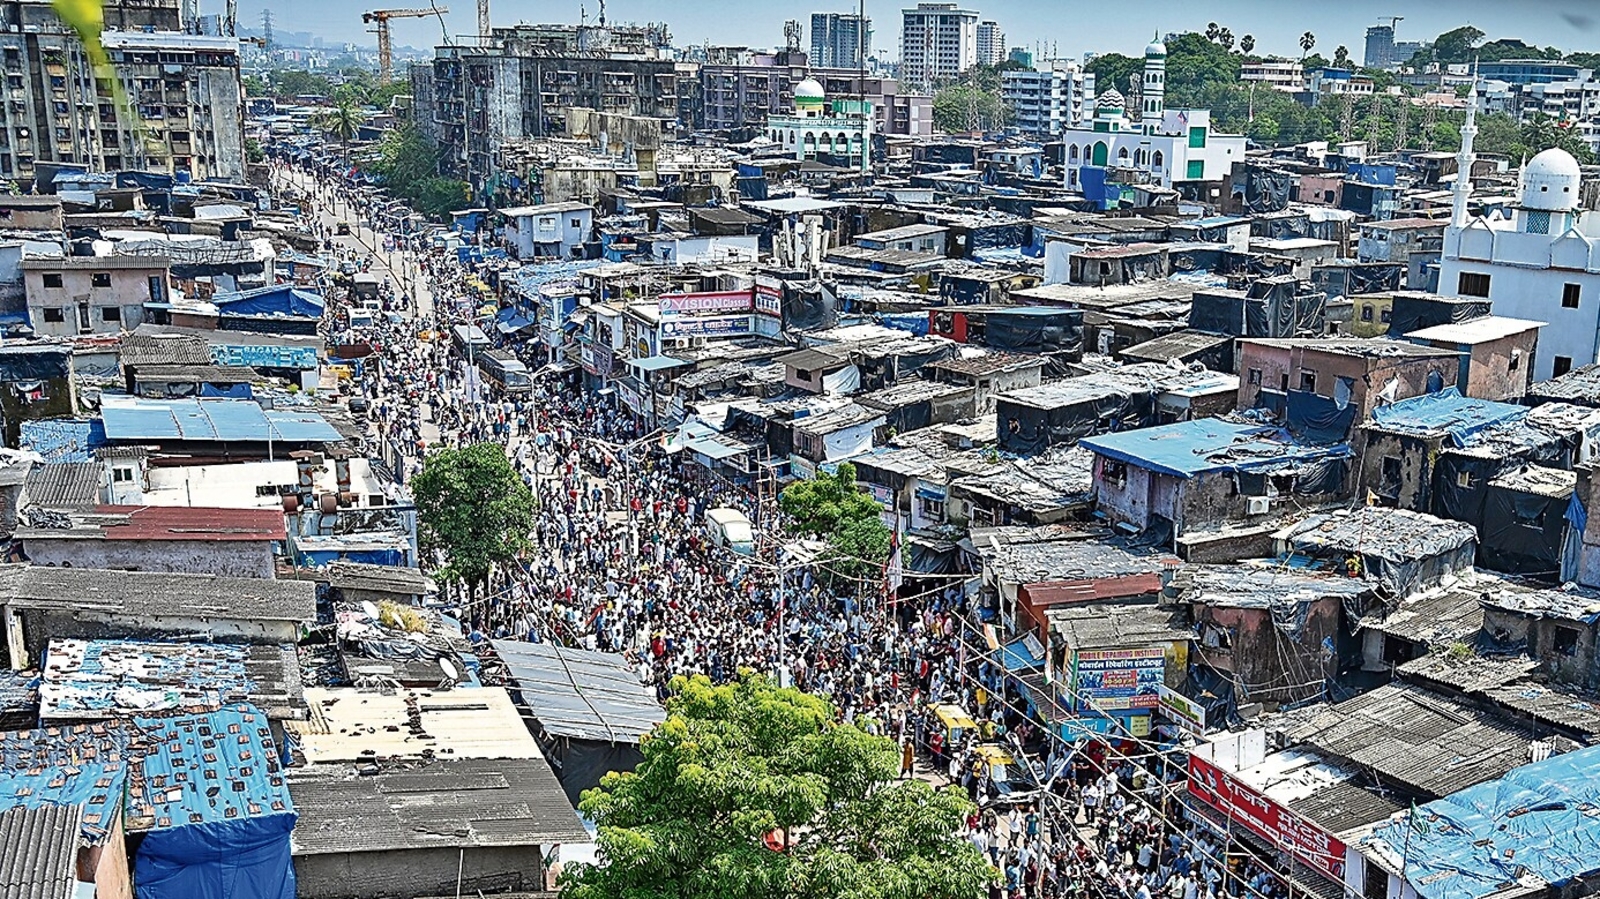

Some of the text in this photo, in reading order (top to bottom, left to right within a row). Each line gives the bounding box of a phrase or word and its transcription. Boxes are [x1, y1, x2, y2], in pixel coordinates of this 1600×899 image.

[672, 296, 722, 309] VISION
[1079, 648, 1163, 659] MOBILE REPAIRING INSTITUTE
